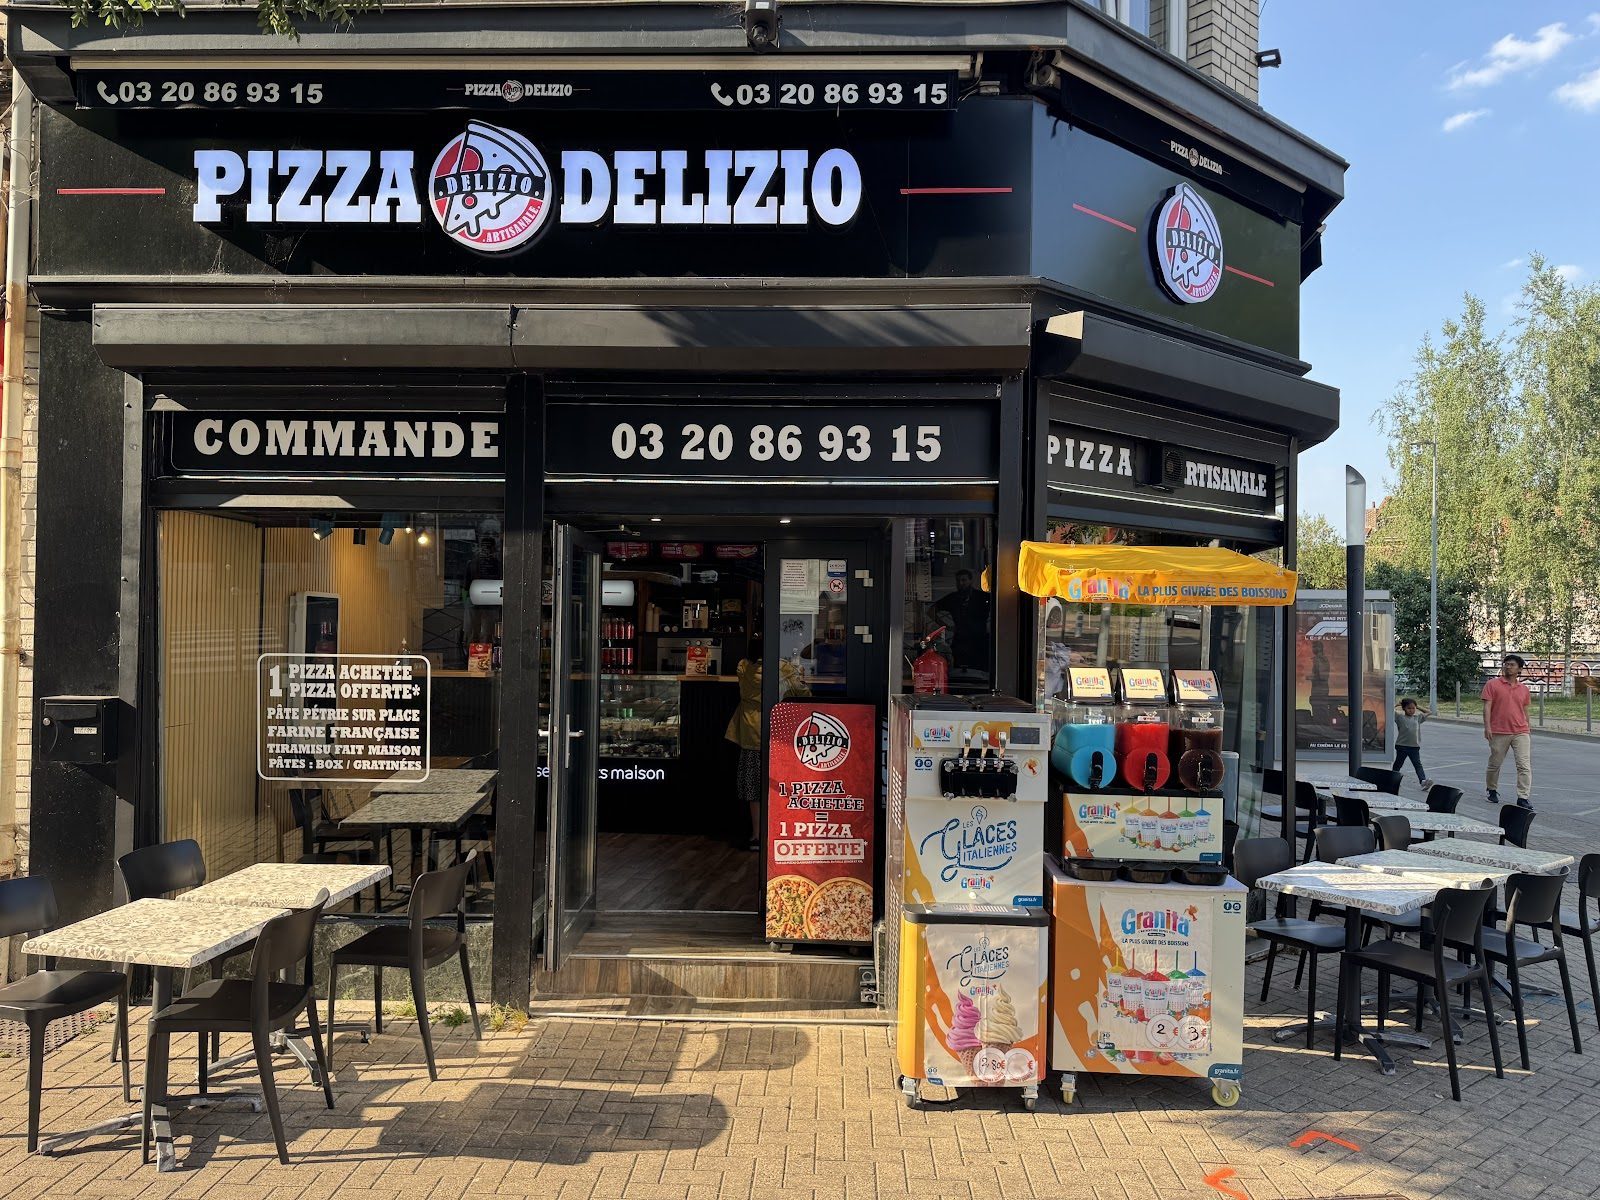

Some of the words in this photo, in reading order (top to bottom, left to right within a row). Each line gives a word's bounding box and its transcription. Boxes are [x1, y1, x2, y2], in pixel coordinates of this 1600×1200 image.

[119, 82, 151, 102] 03
[161, 82, 194, 102] 20
[203, 82, 237, 102] 86
[246, 83, 279, 103] 93
[290, 83, 323, 104] 15
[465, 84, 501, 96] PIZZA
[524, 84, 572, 96] DELIZIO
[736, 84, 770, 105] 03
[780, 83, 814, 104] 20
[824, 83, 858, 104] 86
[868, 83, 903, 104] 93
[913, 83, 947, 104] 15
[1170, 140, 1189, 160] PIZZA
[1199, 155, 1223, 175] DELIZIO
[193, 150, 421, 222] PIZZA
[560, 148, 862, 225] DELIZIO
[445, 173, 532, 194] DELIZIO
[1171, 229, 1215, 261] DELIZIO
[194, 418, 499, 458] COMMANDE
[612, 423, 664, 459] 03
[681, 423, 733, 460] 20
[749, 424, 803, 461] 86
[818, 424, 871, 462] 93
[892, 425, 942, 462] 15
[1047, 434, 1132, 477] PIZZA
[1184, 460, 1267, 497] RTISANALE
[1137, 585, 1149, 597] LA
[1152, 586, 1177, 597] PLUS
[1181, 584, 1216, 597] GIVRÉE
[1219, 587, 1238, 597] DES
[1241, 587, 1288, 599] BOISSONS
[269, 665, 283, 697] 1
[288, 664, 335, 679] PIZZA
[339, 661, 412, 680] ACHETÉE
[289, 682, 336, 698] PIZZA
[267, 704, 299, 720] PÂTE
[303, 704, 349, 720] PÉTRIE
[352, 708, 376, 721] SUR
[379, 709, 420, 722] PLACE
[267, 726, 326, 738] FARINE
[330, 726, 419, 742] FRANÇAISE
[802, 735, 842, 746] DELIZIO
[267, 744, 331, 754] TIRAMISU
[334, 744, 364, 755] FAIT
[368, 745, 421, 756] MAISON
[269, 756, 305, 769] PÂTES
[315, 759, 344, 770] BOX
[353, 758, 422, 771] GRATINÉES
[611, 764, 664, 780] maison
[779, 783, 787, 796] 1
[792, 781, 845, 796] PIZZA
[787, 795, 864, 811] ACHETÉE
[1079, 804, 1117, 819] Granita
[780, 822, 788, 836] 1
[794, 822, 853, 838] PIZZA
[963, 842, 1017, 862] ITALIENNES
[1121, 908, 1191, 938] Granita
[1157, 1024, 1166, 1034] 2
[1188, 1026, 1199, 1042] 3
